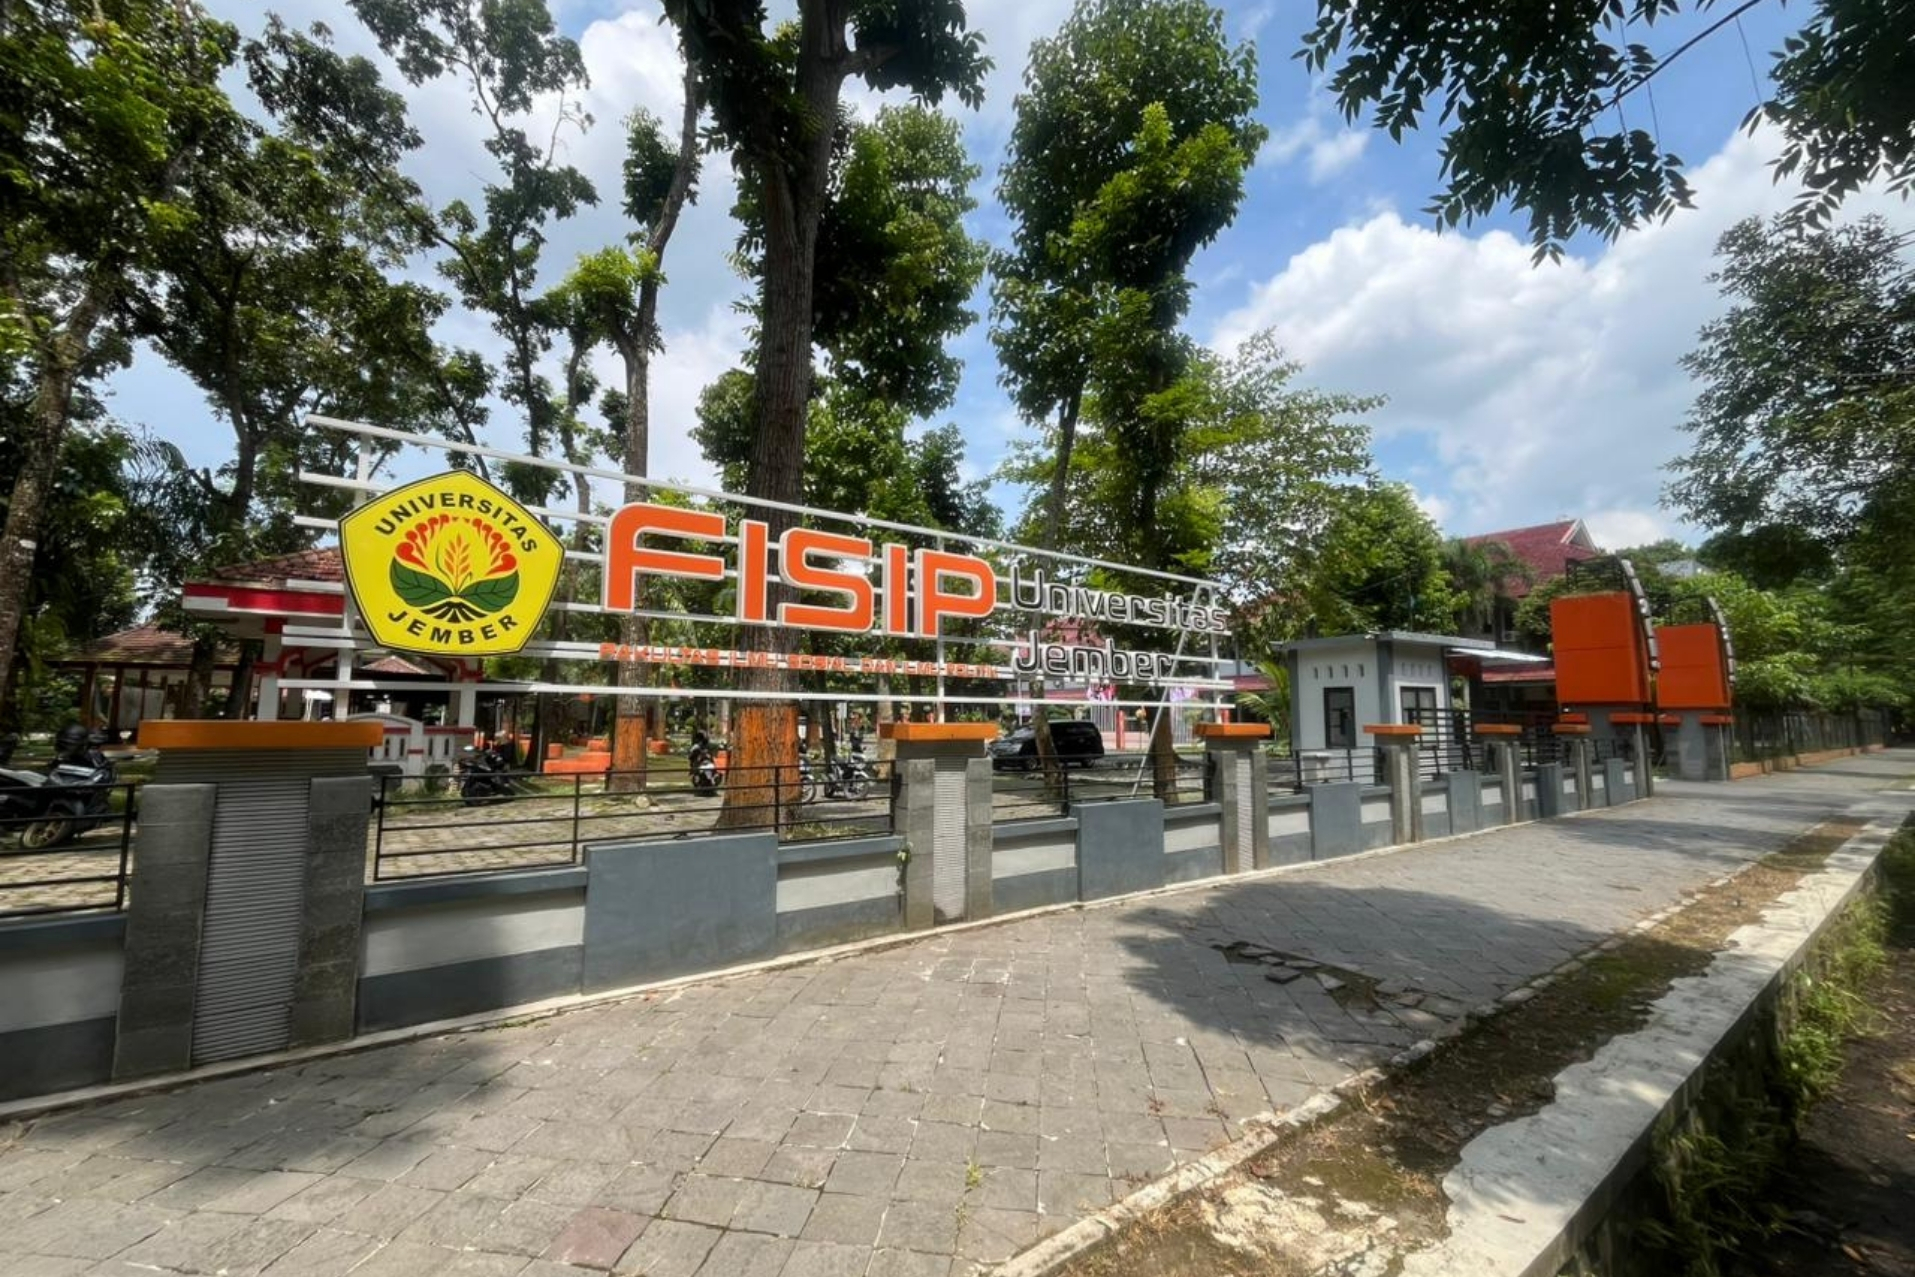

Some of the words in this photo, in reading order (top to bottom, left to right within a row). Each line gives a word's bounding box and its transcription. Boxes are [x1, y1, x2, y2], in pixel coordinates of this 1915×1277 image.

[375, 492, 538, 554] UNIVERSITAS
[605, 502, 997, 639] FISIP
[1010, 563, 1227, 632] Universitas
[387, 608, 518, 646] JEMBER
[1013, 628, 1172, 681] Jember
